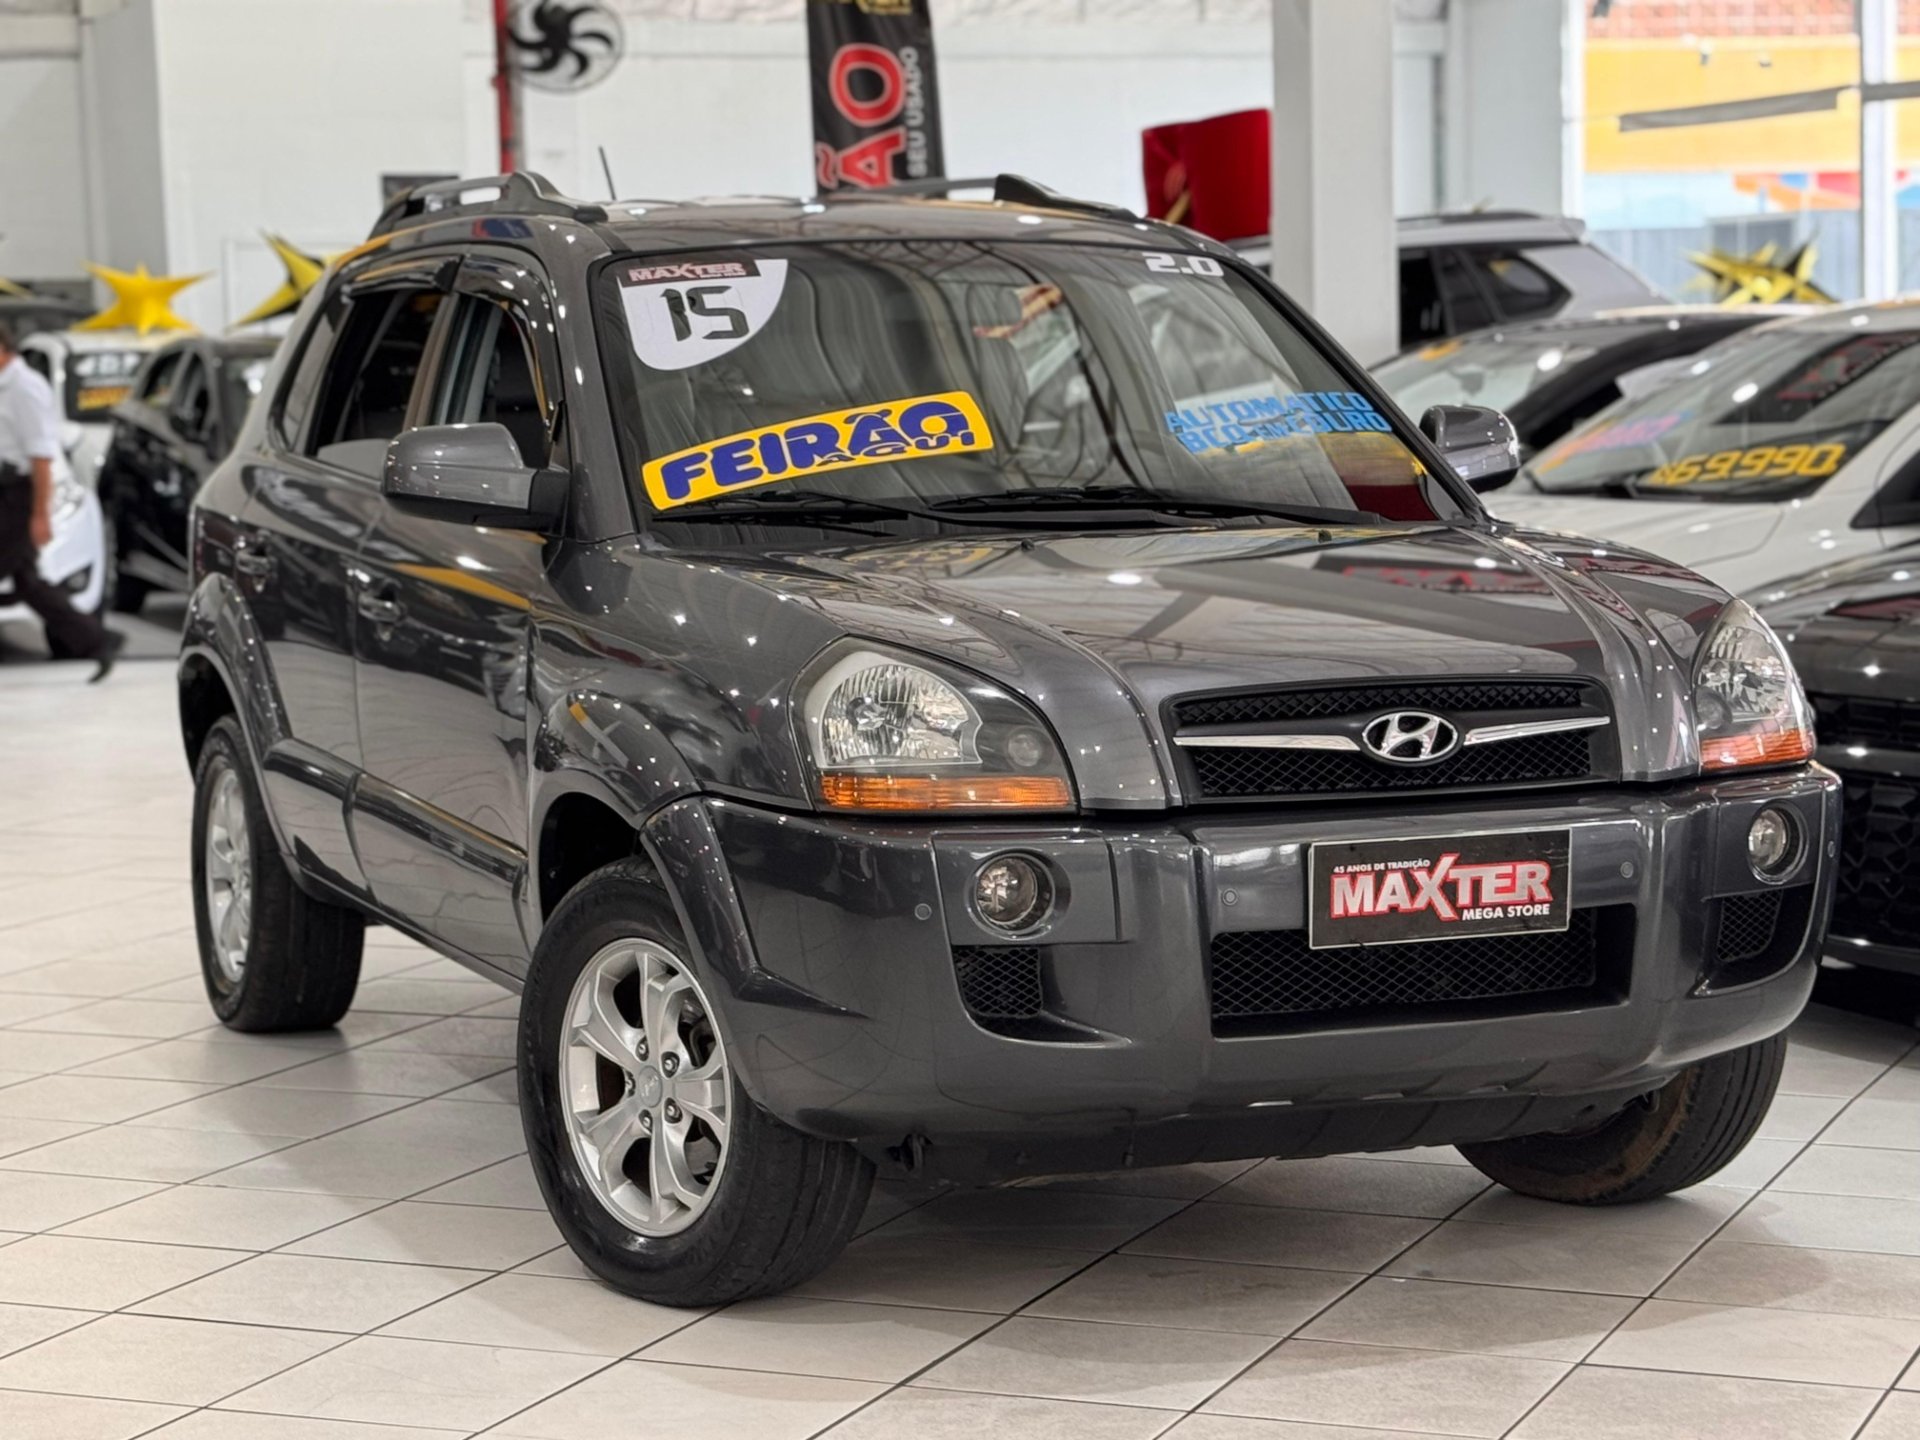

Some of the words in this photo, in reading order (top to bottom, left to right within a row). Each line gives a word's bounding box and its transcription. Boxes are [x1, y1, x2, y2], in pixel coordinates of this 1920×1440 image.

[898, 46, 926, 128] USADO
[905, 130, 928, 178] SEU
[627, 262, 746, 282] MAXTER
[1141, 251, 1225, 278] 2.0
[660, 285, 750, 342] 15
[1164, 391, 1375, 432] AUTOMATICO
[660, 401, 970, 500] FEIRÃO
[1330, 852, 1554, 922] MAXTER
[1333, 865, 1345, 874] 45
[1346, 863, 1372, 873] ANOS
[1373, 862, 1386, 871] DE
[1387, 858, 1431, 871] TRADIÇÃO
[1462, 906, 1504, 922] MEGA
[1507, 903, 1551, 919] STORE
